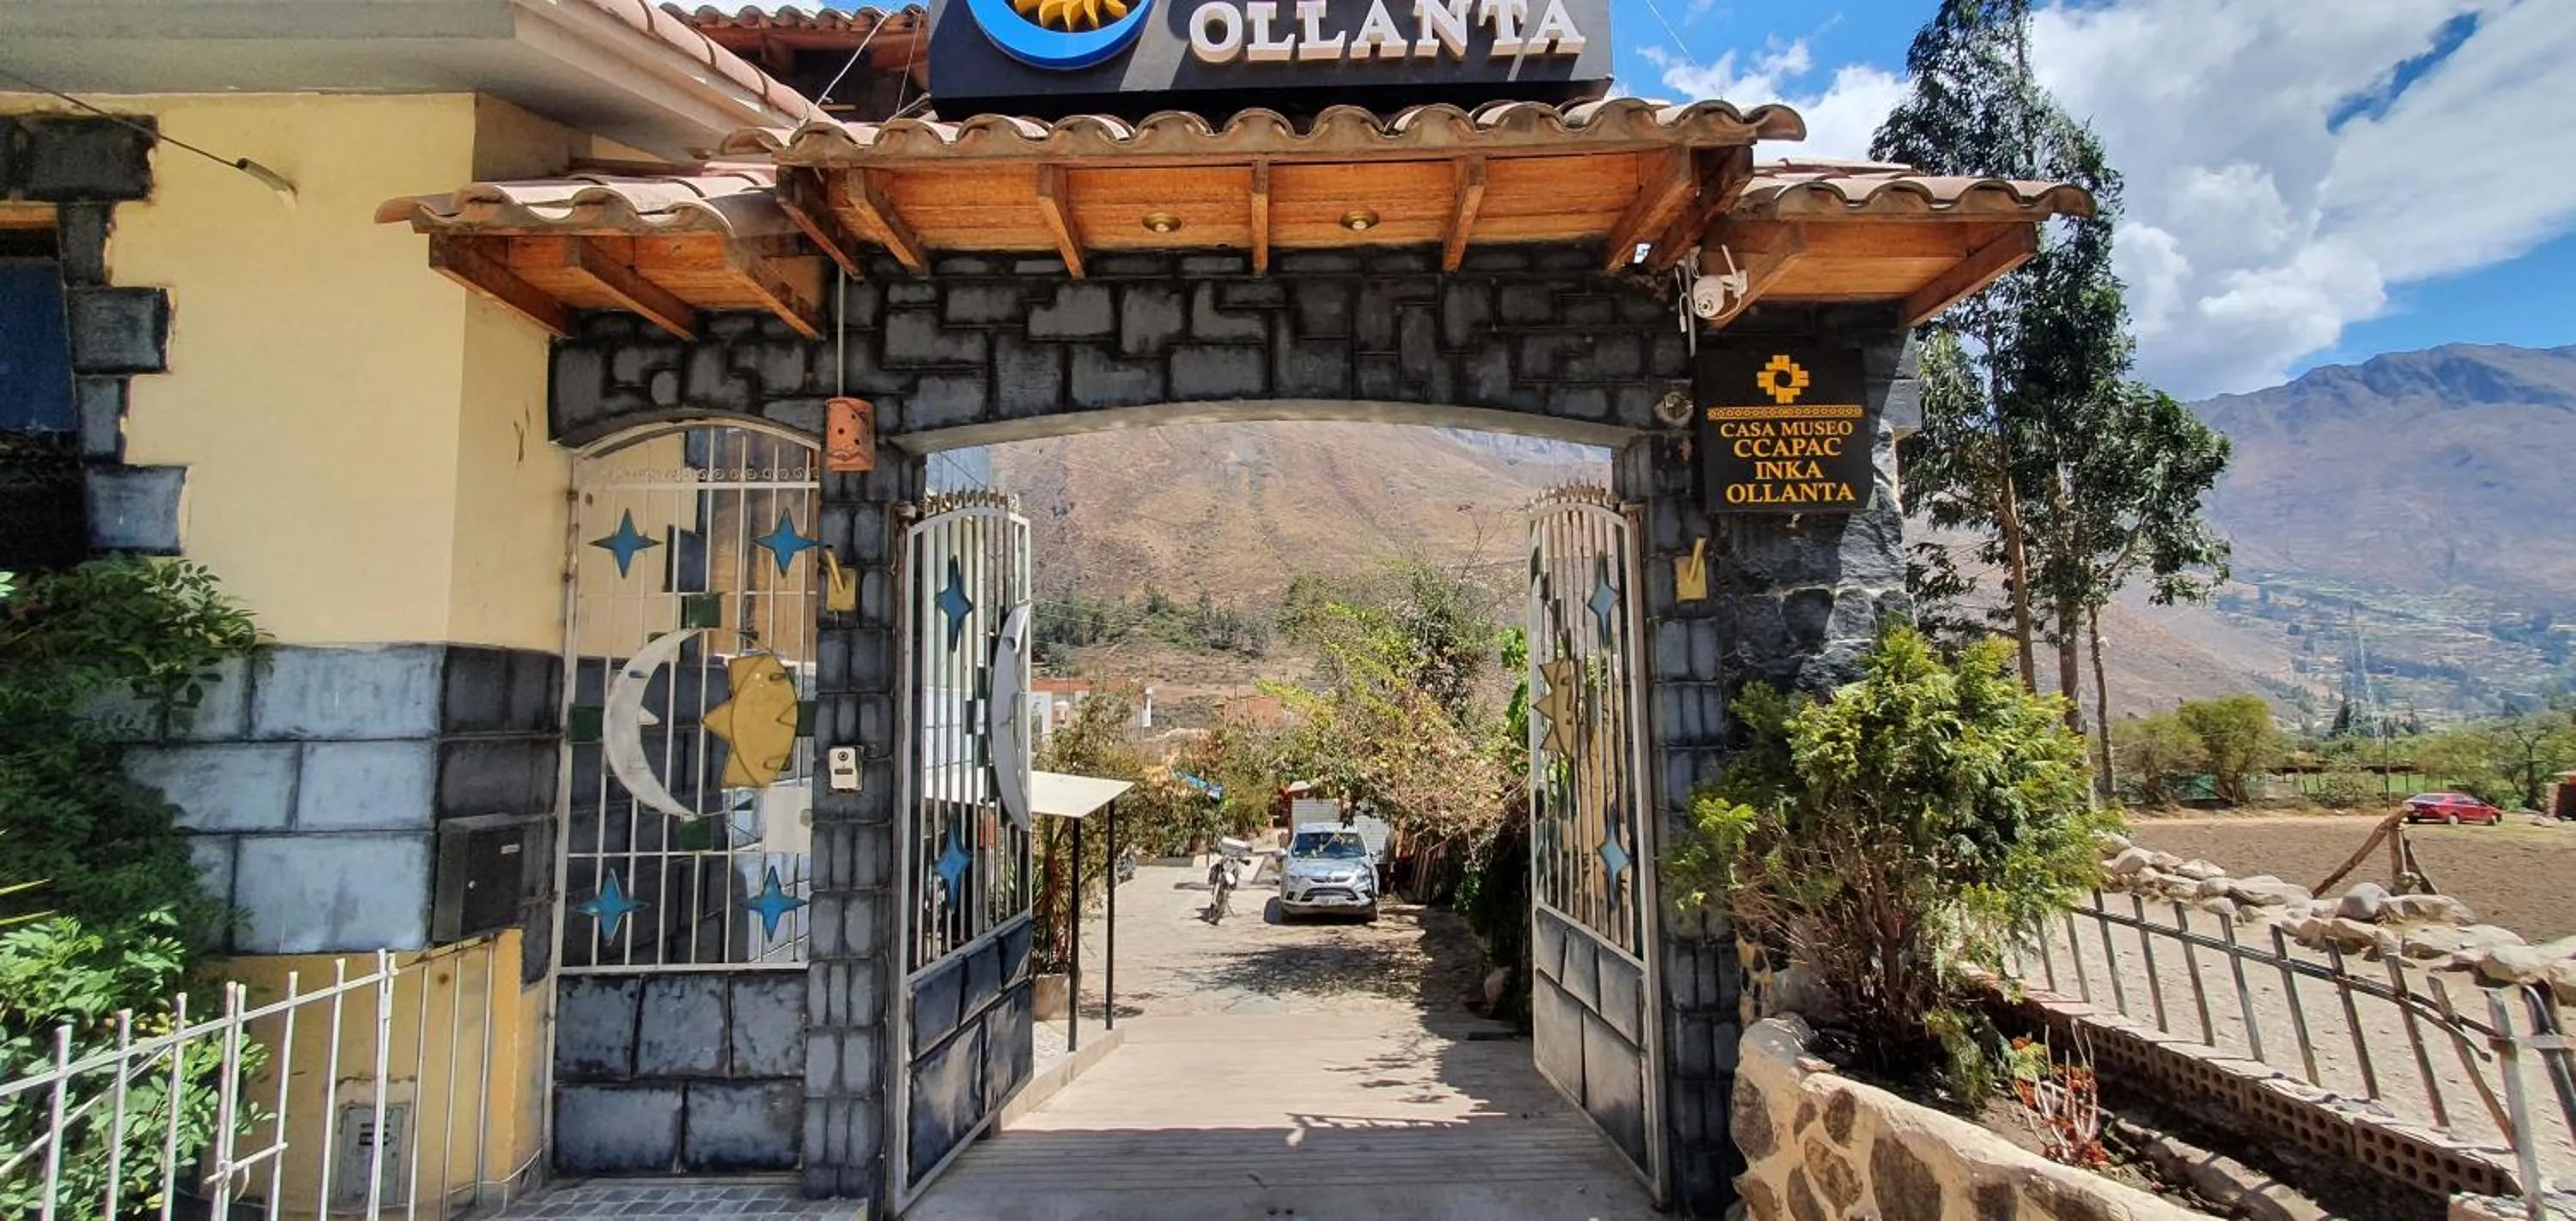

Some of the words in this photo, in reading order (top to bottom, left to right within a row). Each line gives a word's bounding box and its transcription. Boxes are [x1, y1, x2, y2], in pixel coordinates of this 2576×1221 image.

[1189, 0, 1587, 63] OLLANTA
[1720, 422, 1776, 437] CASA
[1780, 420, 1854, 436] MUSEO
[1734, 438, 1842, 458] CCAPAC
[1754, 460, 1825, 480] INKA
[1725, 482, 1856, 503] OLLANTA
